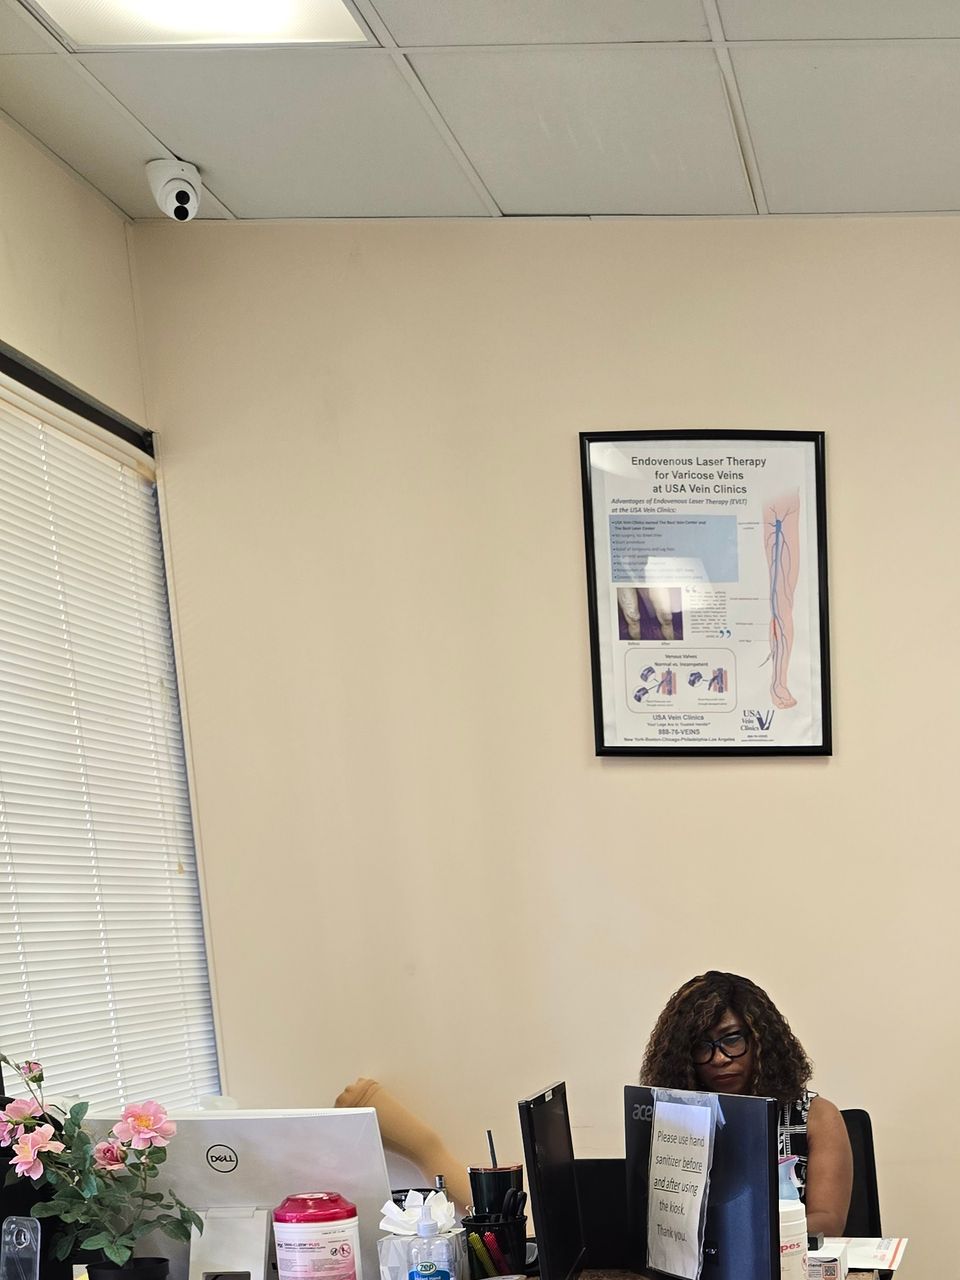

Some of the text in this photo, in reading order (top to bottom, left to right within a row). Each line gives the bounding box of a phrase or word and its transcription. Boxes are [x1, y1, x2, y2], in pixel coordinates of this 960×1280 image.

[631, 456, 766, 468] Endovenous Laser Therapy
[655, 470, 744, 480] for Varicose Veins
[653, 484, 747, 494] at USA Vein Clinics
[632, 1103, 653, 1121] ace
[657, 1130, 705, 1148] Please use hand
[210, 1154, 235, 1163] DELL
[655, 1154, 702, 1171] sanitizer before
[654, 1177, 699, 1197] and after using
[659, 1200, 686, 1216] the kiosk.
[657, 1223, 673, 1238] Thank
